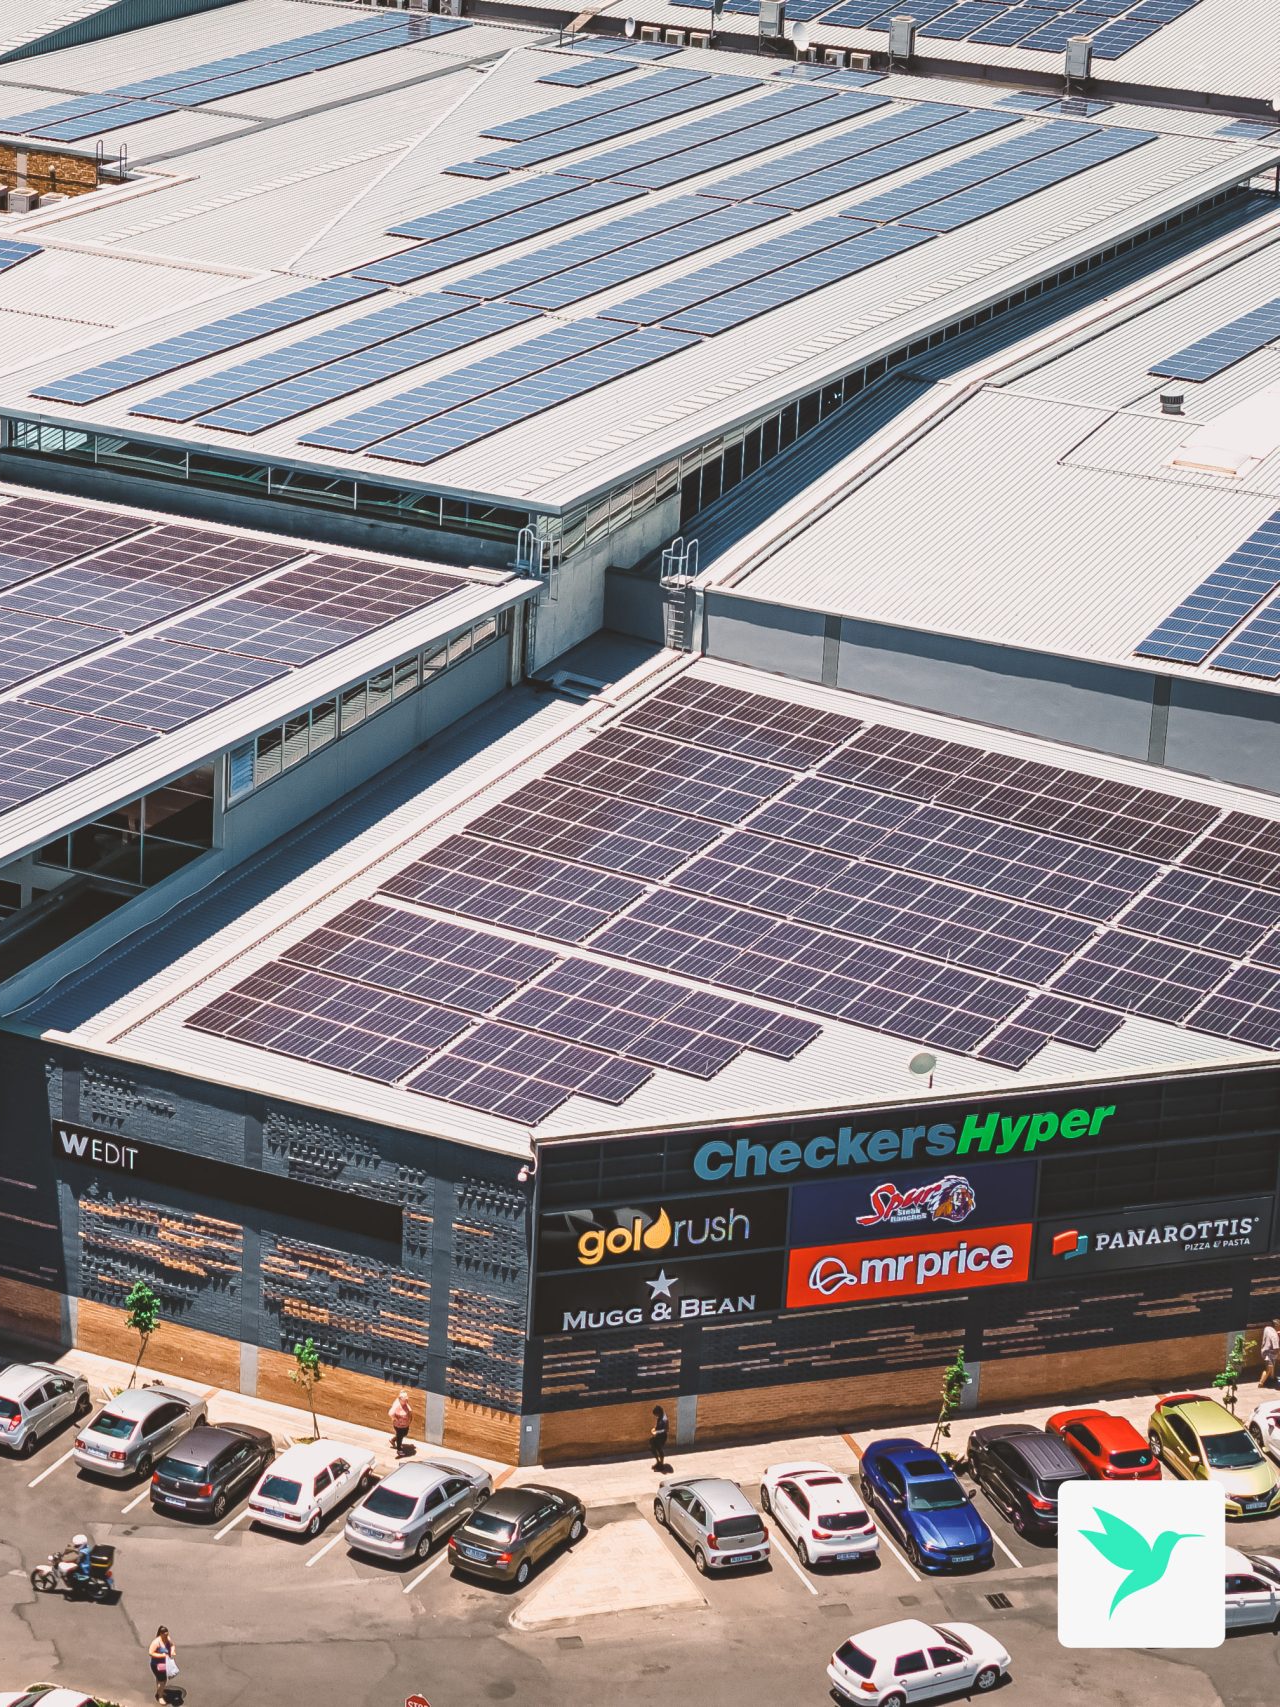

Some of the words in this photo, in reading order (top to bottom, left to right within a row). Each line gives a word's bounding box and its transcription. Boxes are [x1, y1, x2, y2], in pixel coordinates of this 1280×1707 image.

[60, 1131, 89, 1157] W
[92, 1139, 138, 1169] EDIT
[855, 1182, 942, 1226] Spur
[860, 1255, 914, 1285] mr
[916, 1242, 1014, 1285] price
[1184, 1243, 1210, 1251] PIZZA
[1223, 1238, 1250, 1247] PASTA
[651, 1302, 672, 1321] &
